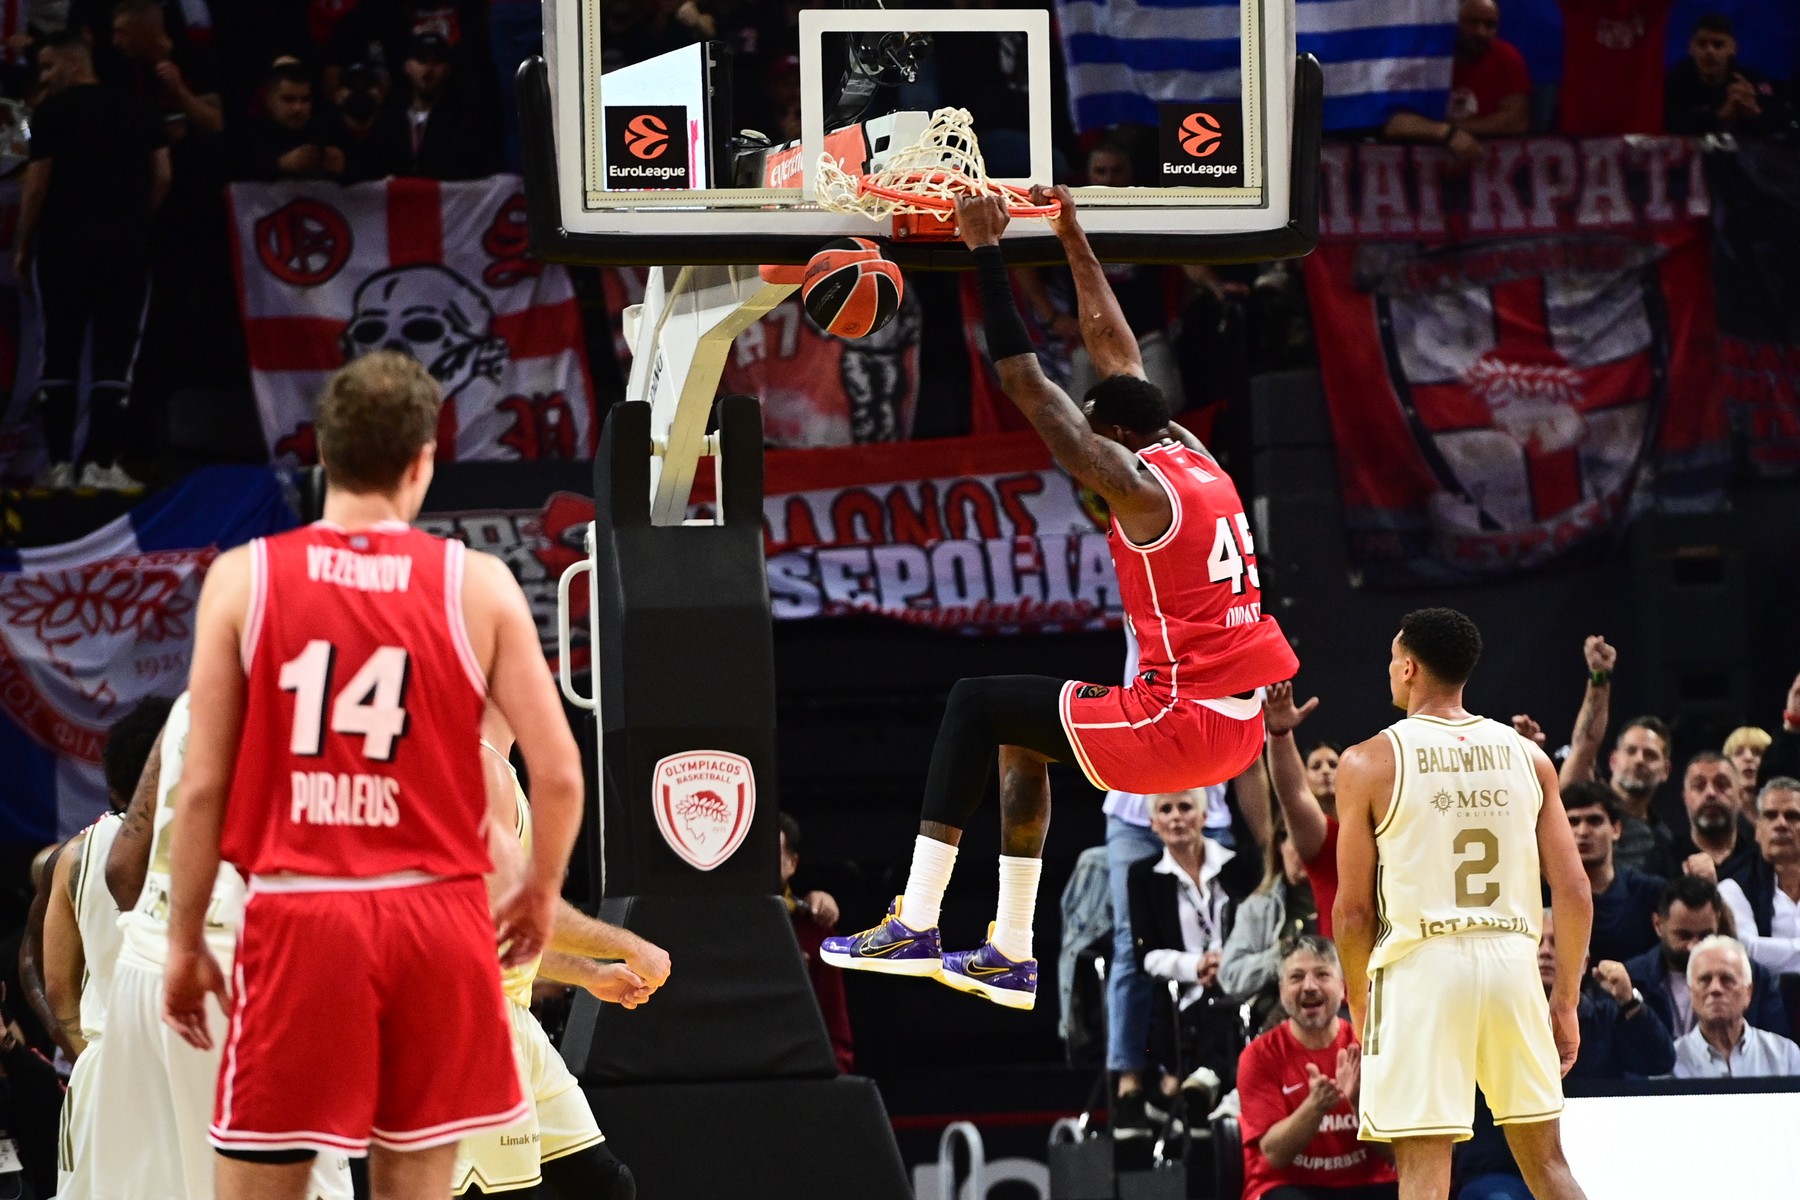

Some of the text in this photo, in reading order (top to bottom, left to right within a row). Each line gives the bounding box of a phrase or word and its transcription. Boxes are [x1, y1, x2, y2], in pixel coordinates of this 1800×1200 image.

[609, 165, 686, 180] EuroLeague
[1162, 162, 1238, 178] EuroLeague
[306, 544, 413, 593] VEZENKOV
[765, 533, 1122, 620] SEPOLIA
[278, 639, 409, 761] 14
[665, 760, 741, 777] OLYMPIACOS
[1416, 745, 1512, 774] BALDWIN IV
[676, 772, 732, 785] BASKETBALL
[290, 770, 400, 827] PIRAEUS
[1456, 789, 1509, 808] MSC
[1456, 810, 1510, 818] CRUISES
[1453, 828, 1500, 908] 2
[500, 1133, 530, 1146] Limak
[1293, 1147, 1367, 1171] SUPERBET
